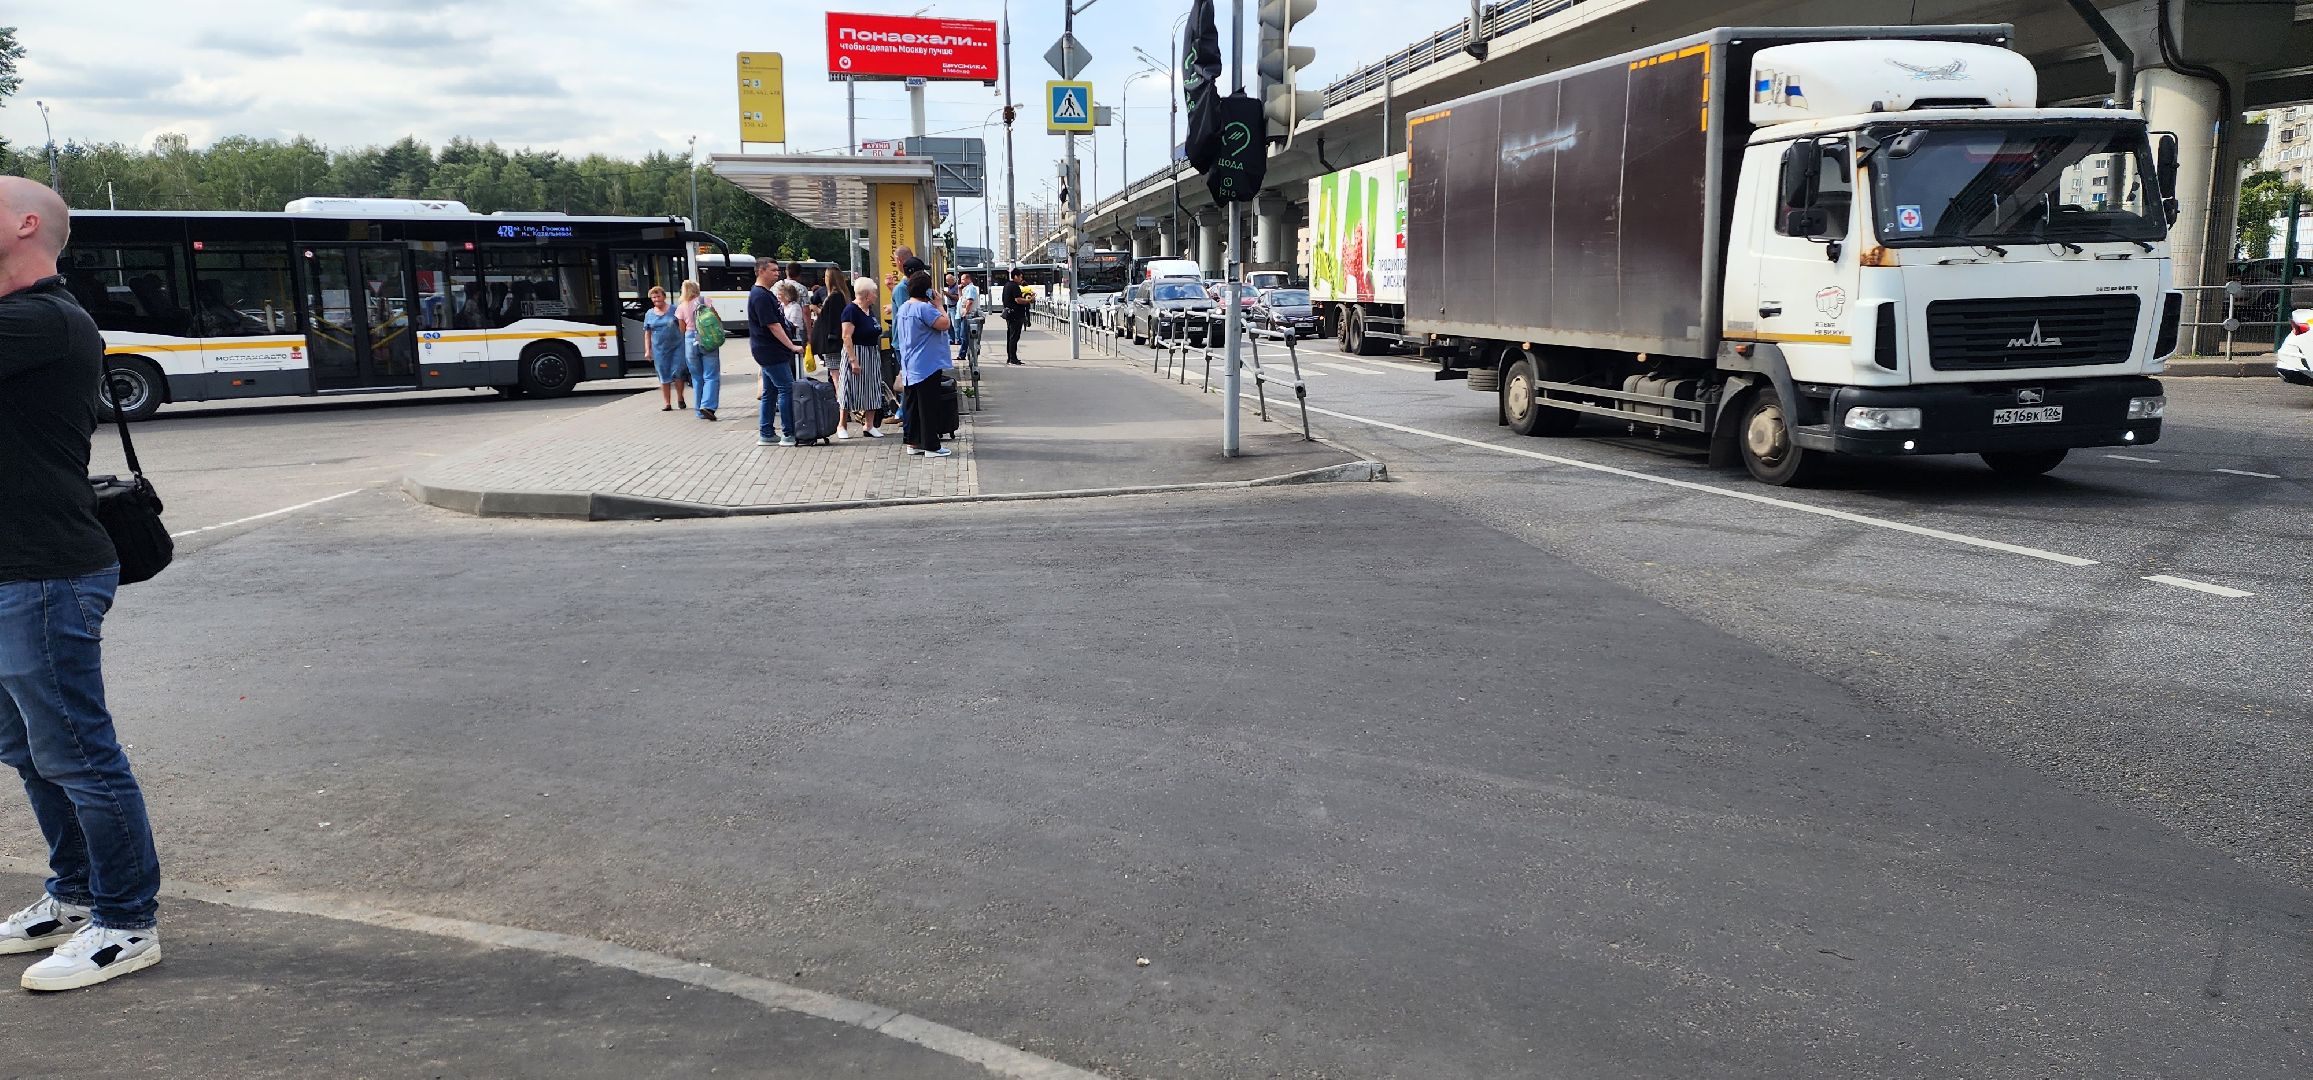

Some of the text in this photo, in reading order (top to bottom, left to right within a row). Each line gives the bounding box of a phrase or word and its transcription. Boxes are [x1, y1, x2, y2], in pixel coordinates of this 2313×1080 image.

[839, 27, 988, 47] Понаехали...
[839, 42, 865, 51] чтобы
[866, 45, 898, 53] сделать
[899, 46, 927, 55] Москву
[497, 225, 515, 237] 478
[1378, 258, 1407, 273] ПРОДУКТОВ
